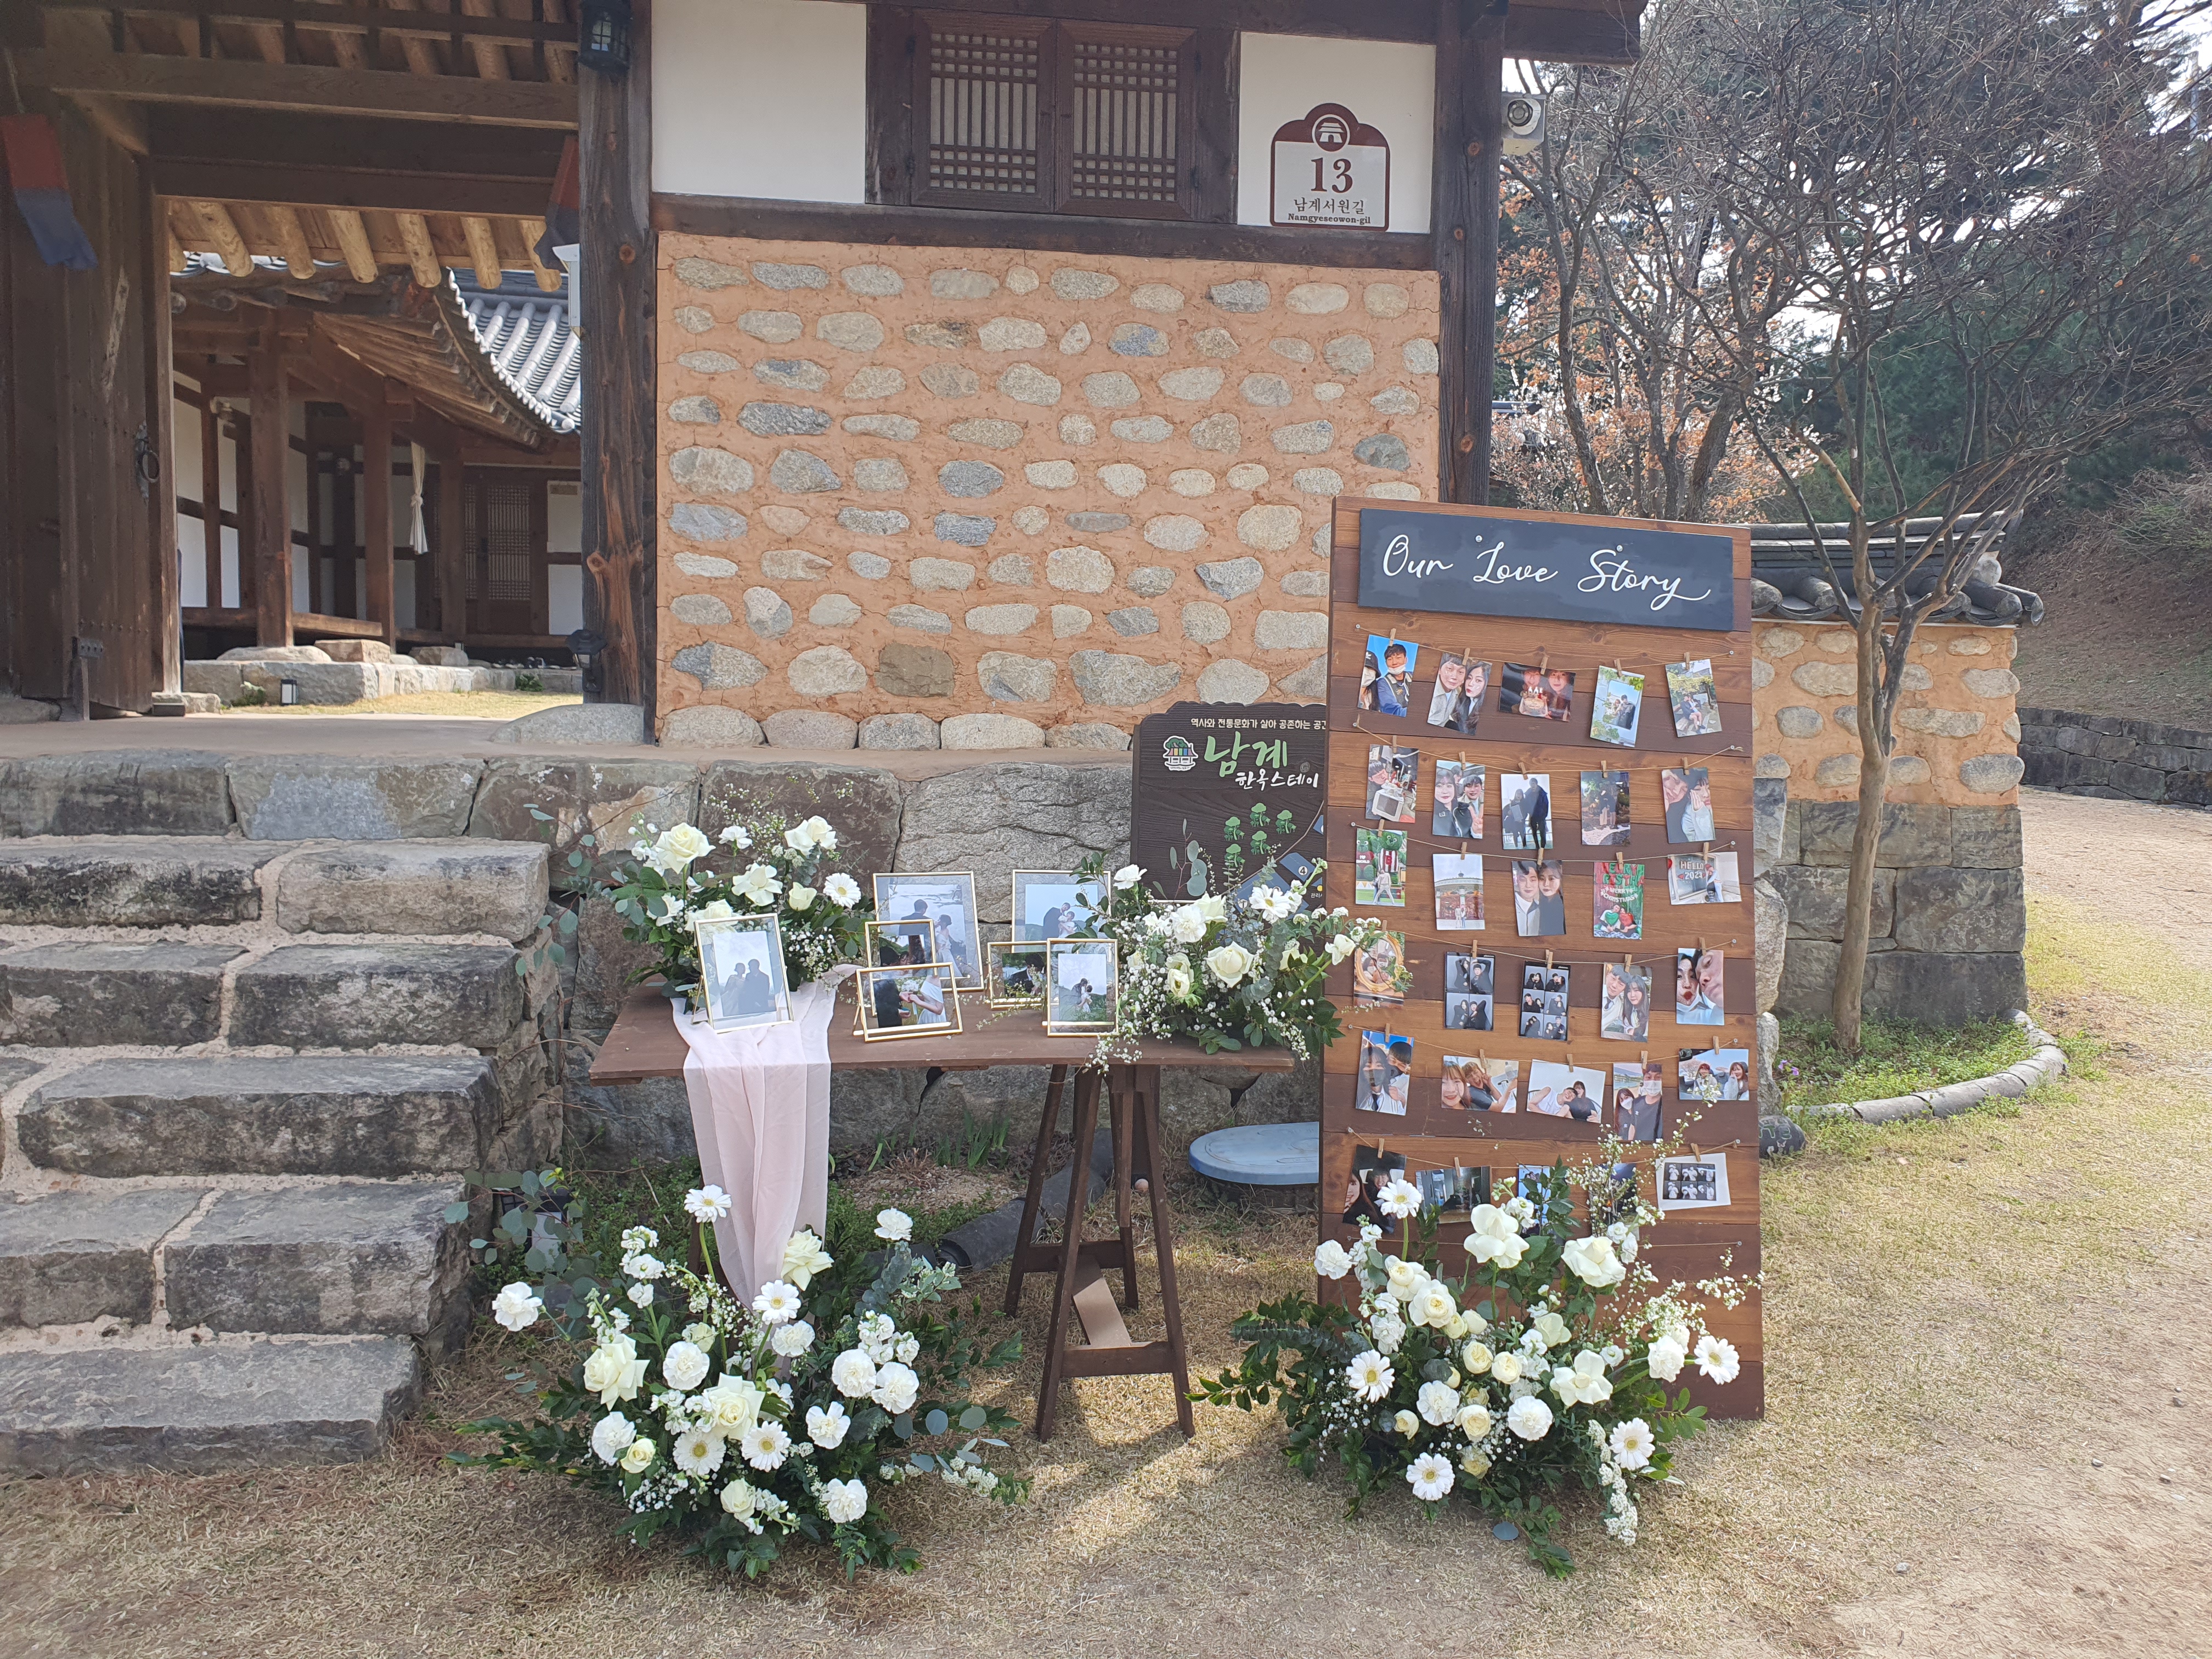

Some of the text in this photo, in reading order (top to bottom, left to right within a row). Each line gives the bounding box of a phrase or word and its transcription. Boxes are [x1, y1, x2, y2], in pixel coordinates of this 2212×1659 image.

[1311, 157, 1353, 193] 13
[1294, 198, 1364, 215] 남계서원길
[1288, 213, 1371, 225] Namgyeseowon-gil
[1383, 534, 1711, 611] Our Love Story
[1190, 718, 1215, 728] 역사와
[1217, 719, 1258, 729] 전통문화가
[1260, 719, 1277, 729] 살아
[1279, 720, 1311, 730] 공존하는
[1204, 731, 1288, 777] 남계
[1235, 769, 1319, 791] 한옥스테이
[1680, 860, 1704, 870] HELLO
